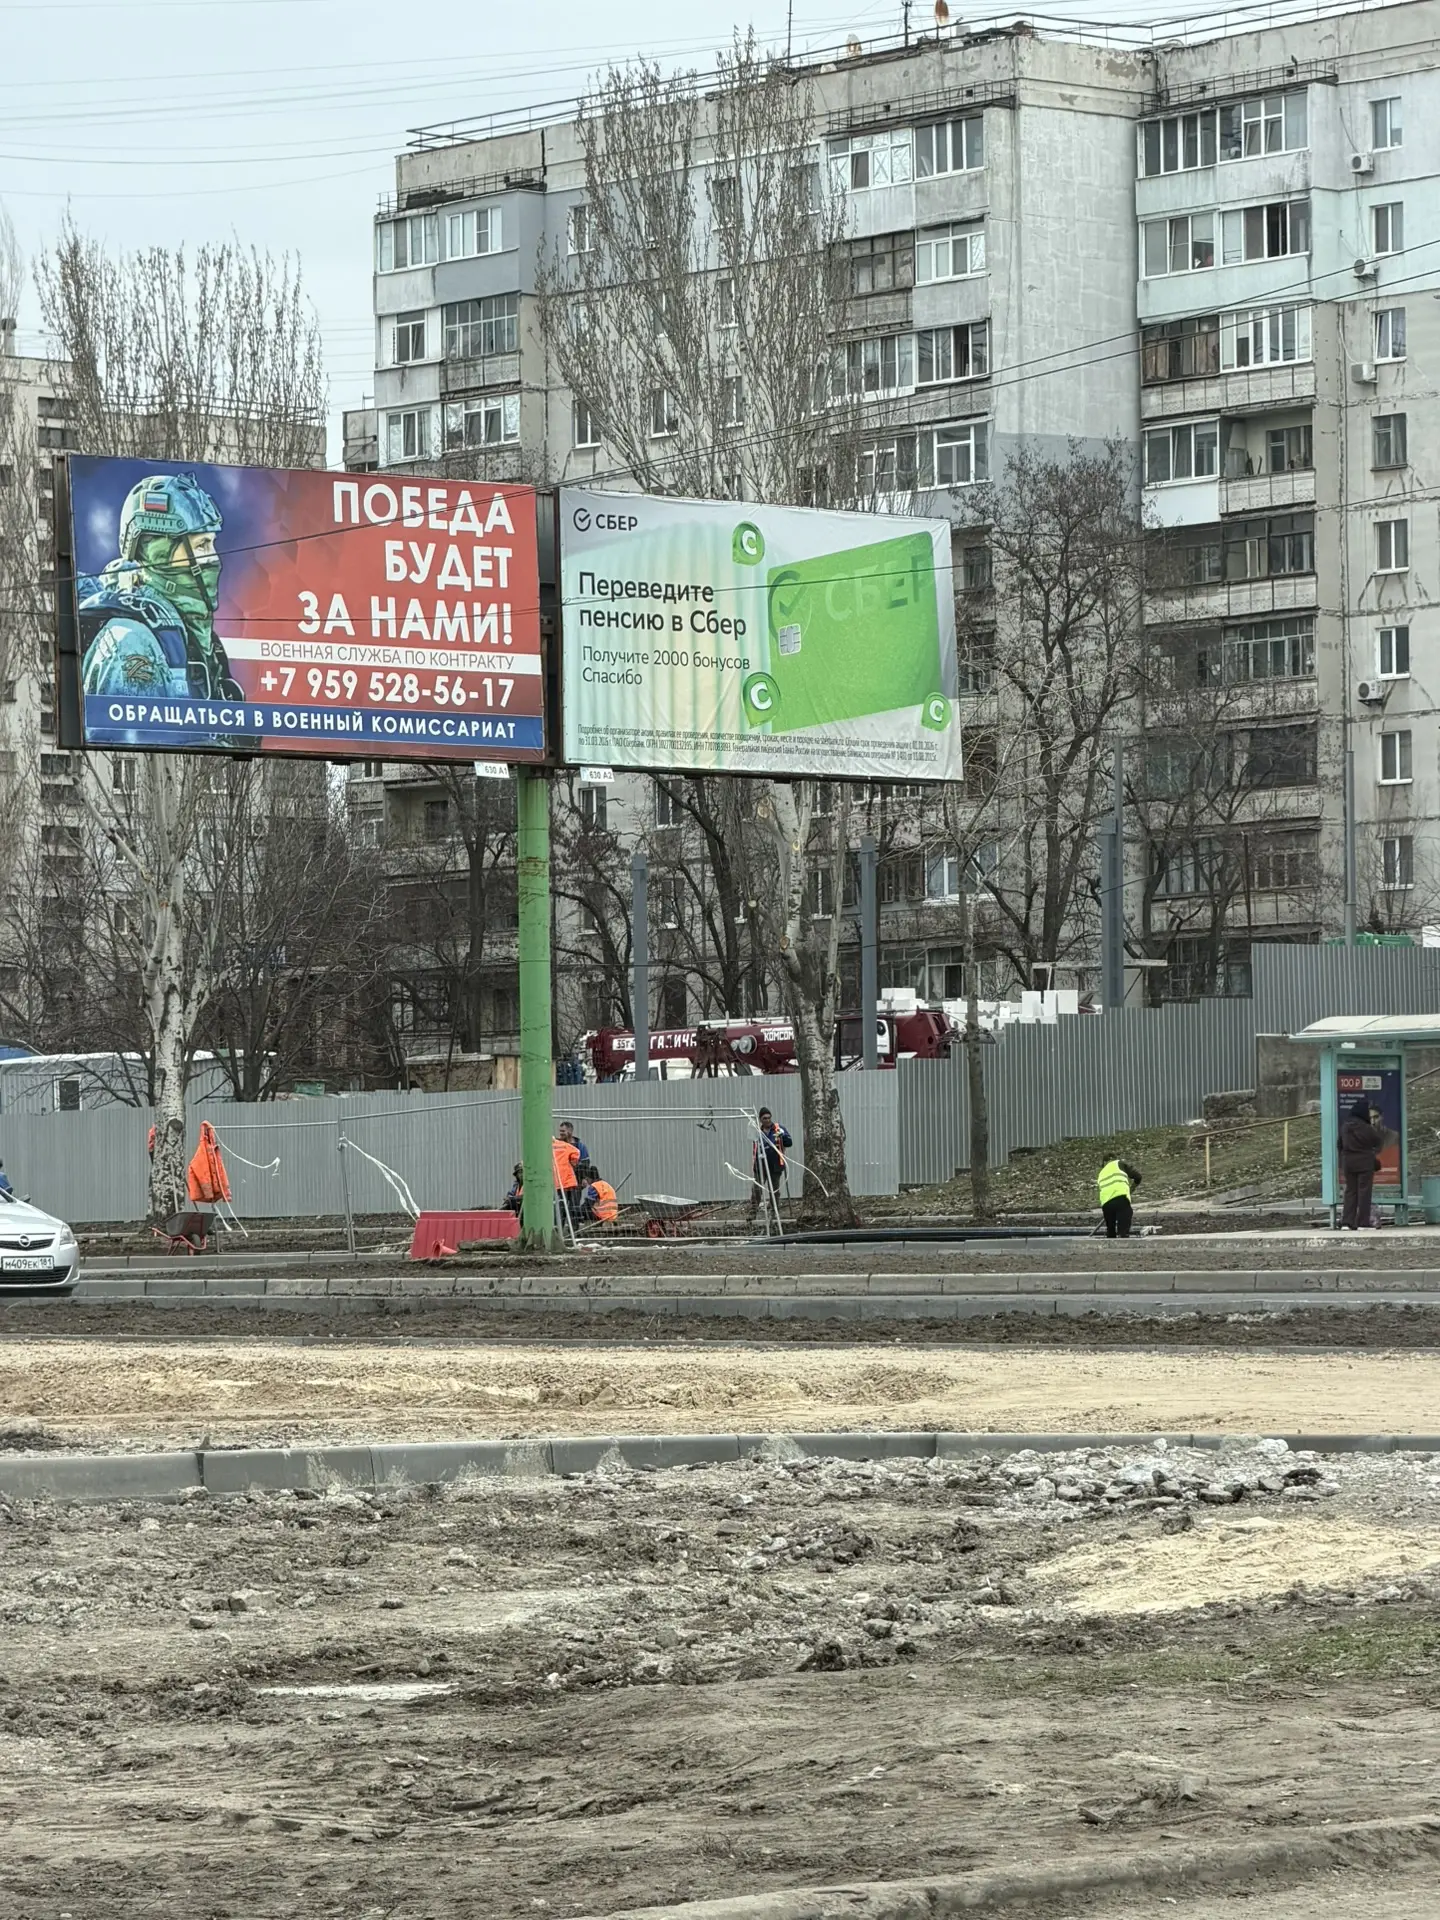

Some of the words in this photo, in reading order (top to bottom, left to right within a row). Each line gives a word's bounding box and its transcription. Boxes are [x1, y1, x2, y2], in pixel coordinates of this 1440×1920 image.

[333, 481, 515, 538] ПОБЕДА
[595, 513, 638, 532] СБЕР
[385, 540, 513, 592] БУДЕТ
[579, 571, 714, 605] Переведите
[297, 590, 356, 636] ЗА
[370, 595, 513, 645] НАМИ!
[579, 609, 665, 631] пенсию
[671, 615, 683, 632] в
[689, 610, 747, 640] Сбер
[260, 642, 333, 660] ВОЕННАЯ
[337, 646, 402, 665] СЛУЖБА
[404, 651, 426, 666] ПО
[430, 652, 514, 670] КОНТРАКТУ
[582, 645, 649, 666] Получите
[653, 649, 689, 667] 2000
[692, 651, 750, 672] бонусов
[260, 666, 297, 697] +7
[307, 667, 358, 700] 959
[368, 671, 515, 709] 528-56-17
[582, 667, 643, 686] Спасибо
[108, 703, 245, 727] ОБРАЩАТЬСЯ
[254, 710, 264, 727] В
[272, 711, 364, 732] ВОЕННЫЙ
[371, 715, 516, 739] КОМИССАРИАТ
[484, 766, 497, 775] 630
[589, 771, 601, 780] 630
[763, 1030, 795, 1042] КОМСОМ
[1340, 1078, 1355, 1088] 100
